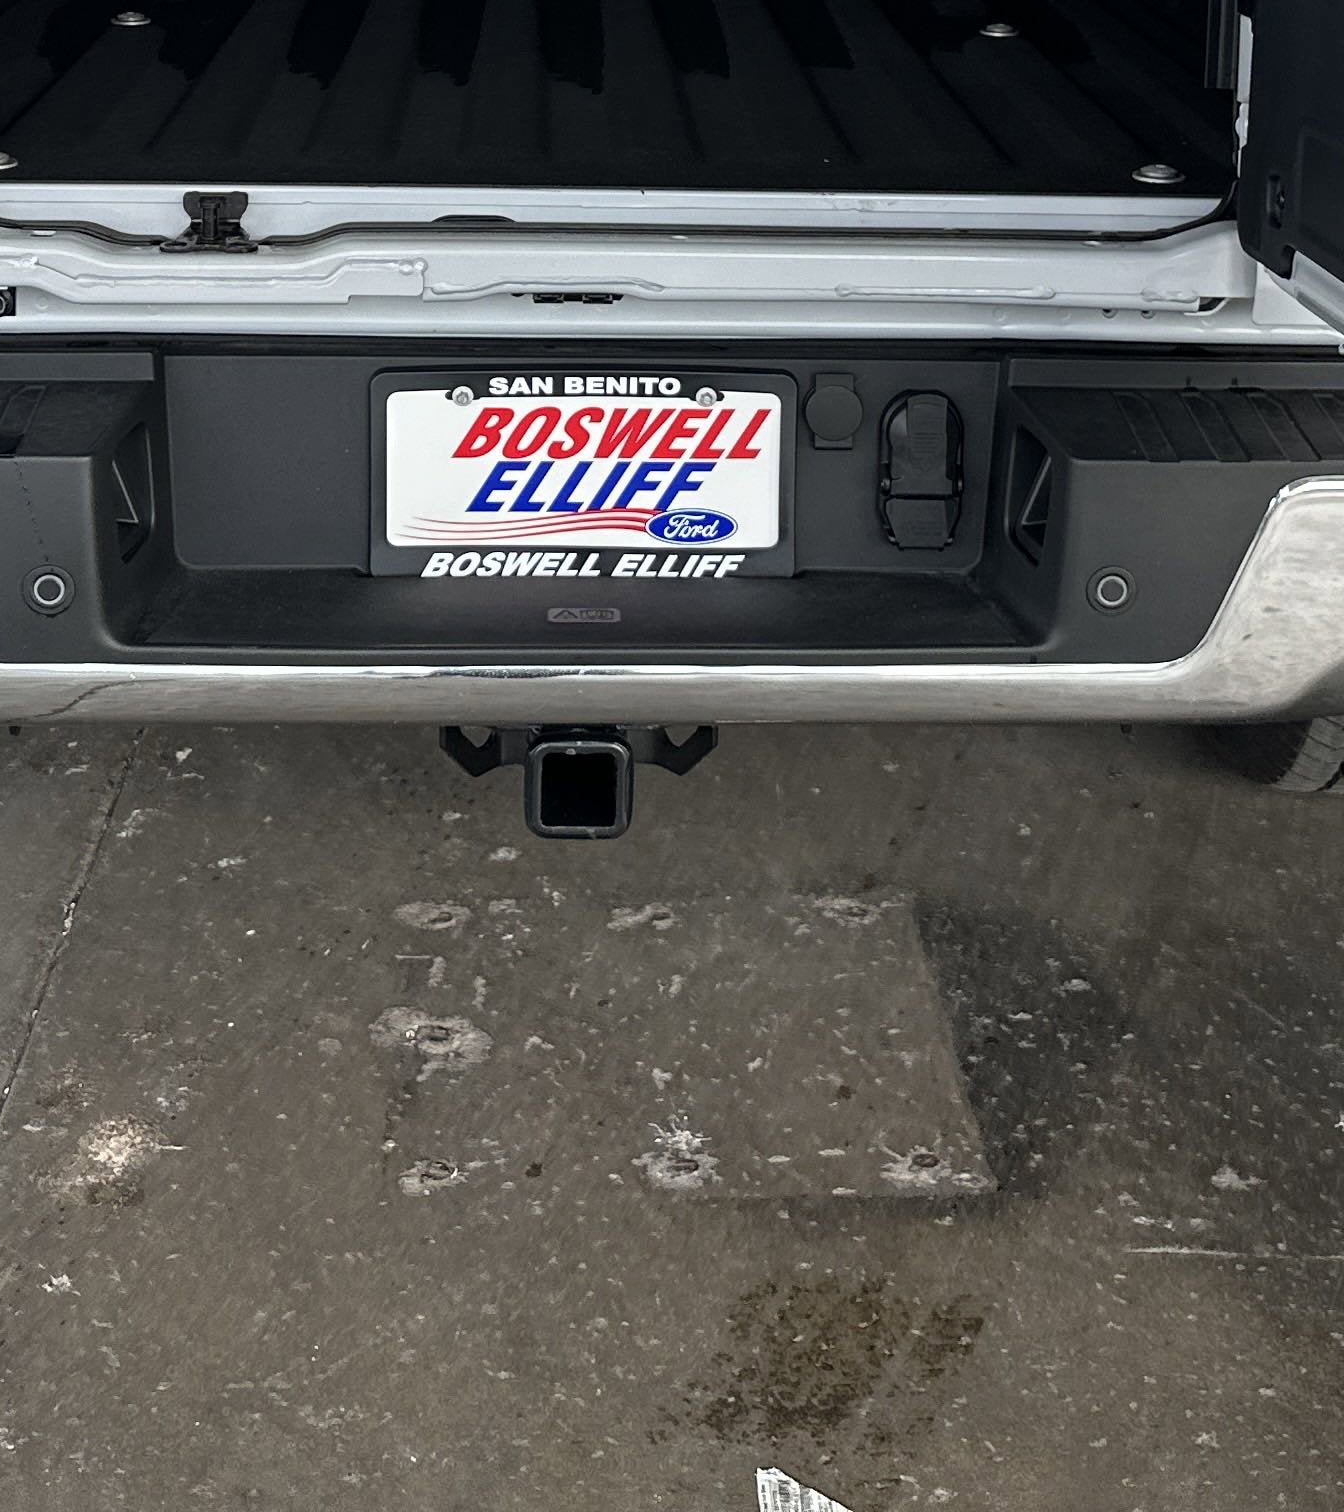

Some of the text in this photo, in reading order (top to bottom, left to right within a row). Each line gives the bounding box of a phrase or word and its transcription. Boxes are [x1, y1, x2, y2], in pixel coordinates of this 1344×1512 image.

[488, 376, 681, 396] SAN BENITO
[450, 406, 772, 459] BOSWELL
[465, 461, 718, 513] ELLIFF
[663, 513, 720, 540] Ford
[420, 552, 746, 578] BOSWELL ELLIFF
